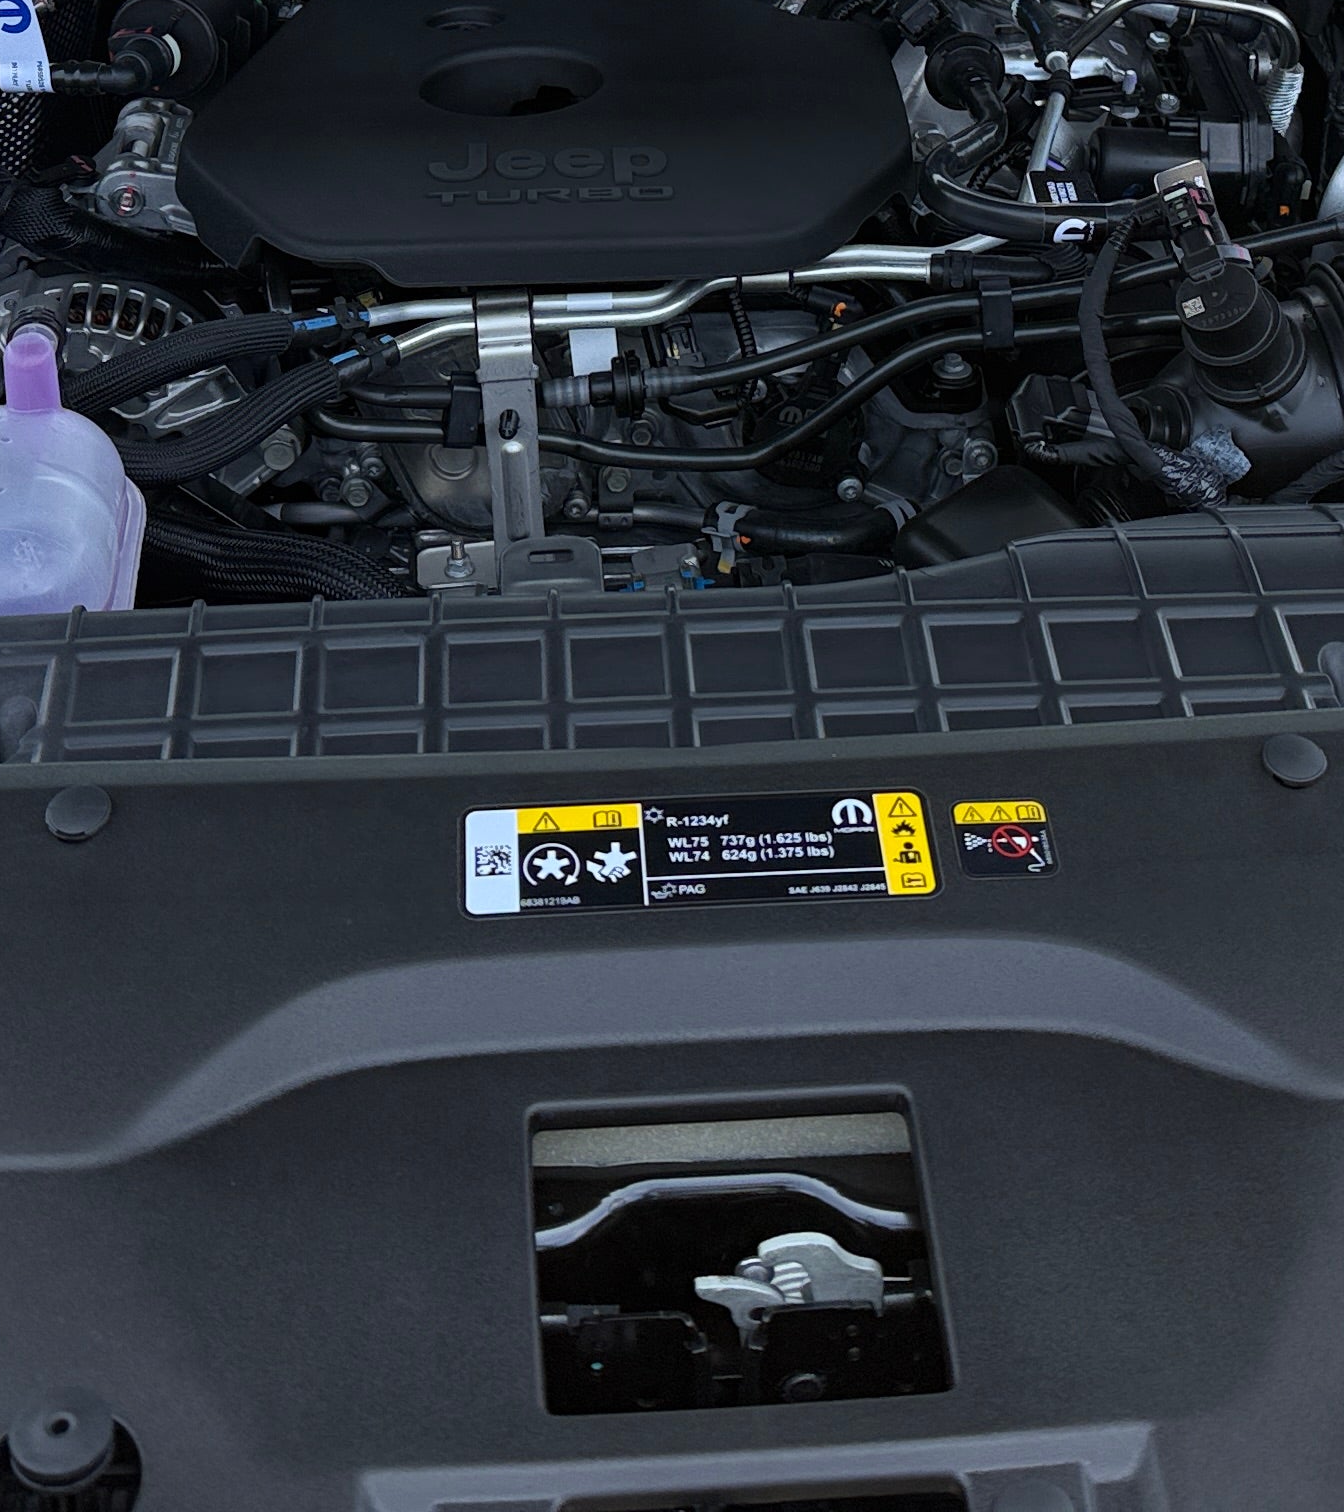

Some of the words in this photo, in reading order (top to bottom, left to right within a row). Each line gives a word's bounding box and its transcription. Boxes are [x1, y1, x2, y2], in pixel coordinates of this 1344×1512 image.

[426, 142, 668, 186] Jeep
[426, 187, 674, 207] TURBO
[666, 814, 729, 828] R-1234yf
[667, 836, 710, 848] WL75
[720, 834, 756, 848] 737g
[758, 832, 803, 847] (1.625
[805, 831, 833, 844] lbs)
[668, 850, 711, 862] WL74
[722, 849, 757, 863] 624g
[760, 846, 805, 861] (1.375
[807, 845, 835, 859] lbs)
[678, 884, 706, 895] PAG
[788, 886, 808, 894] SAE
